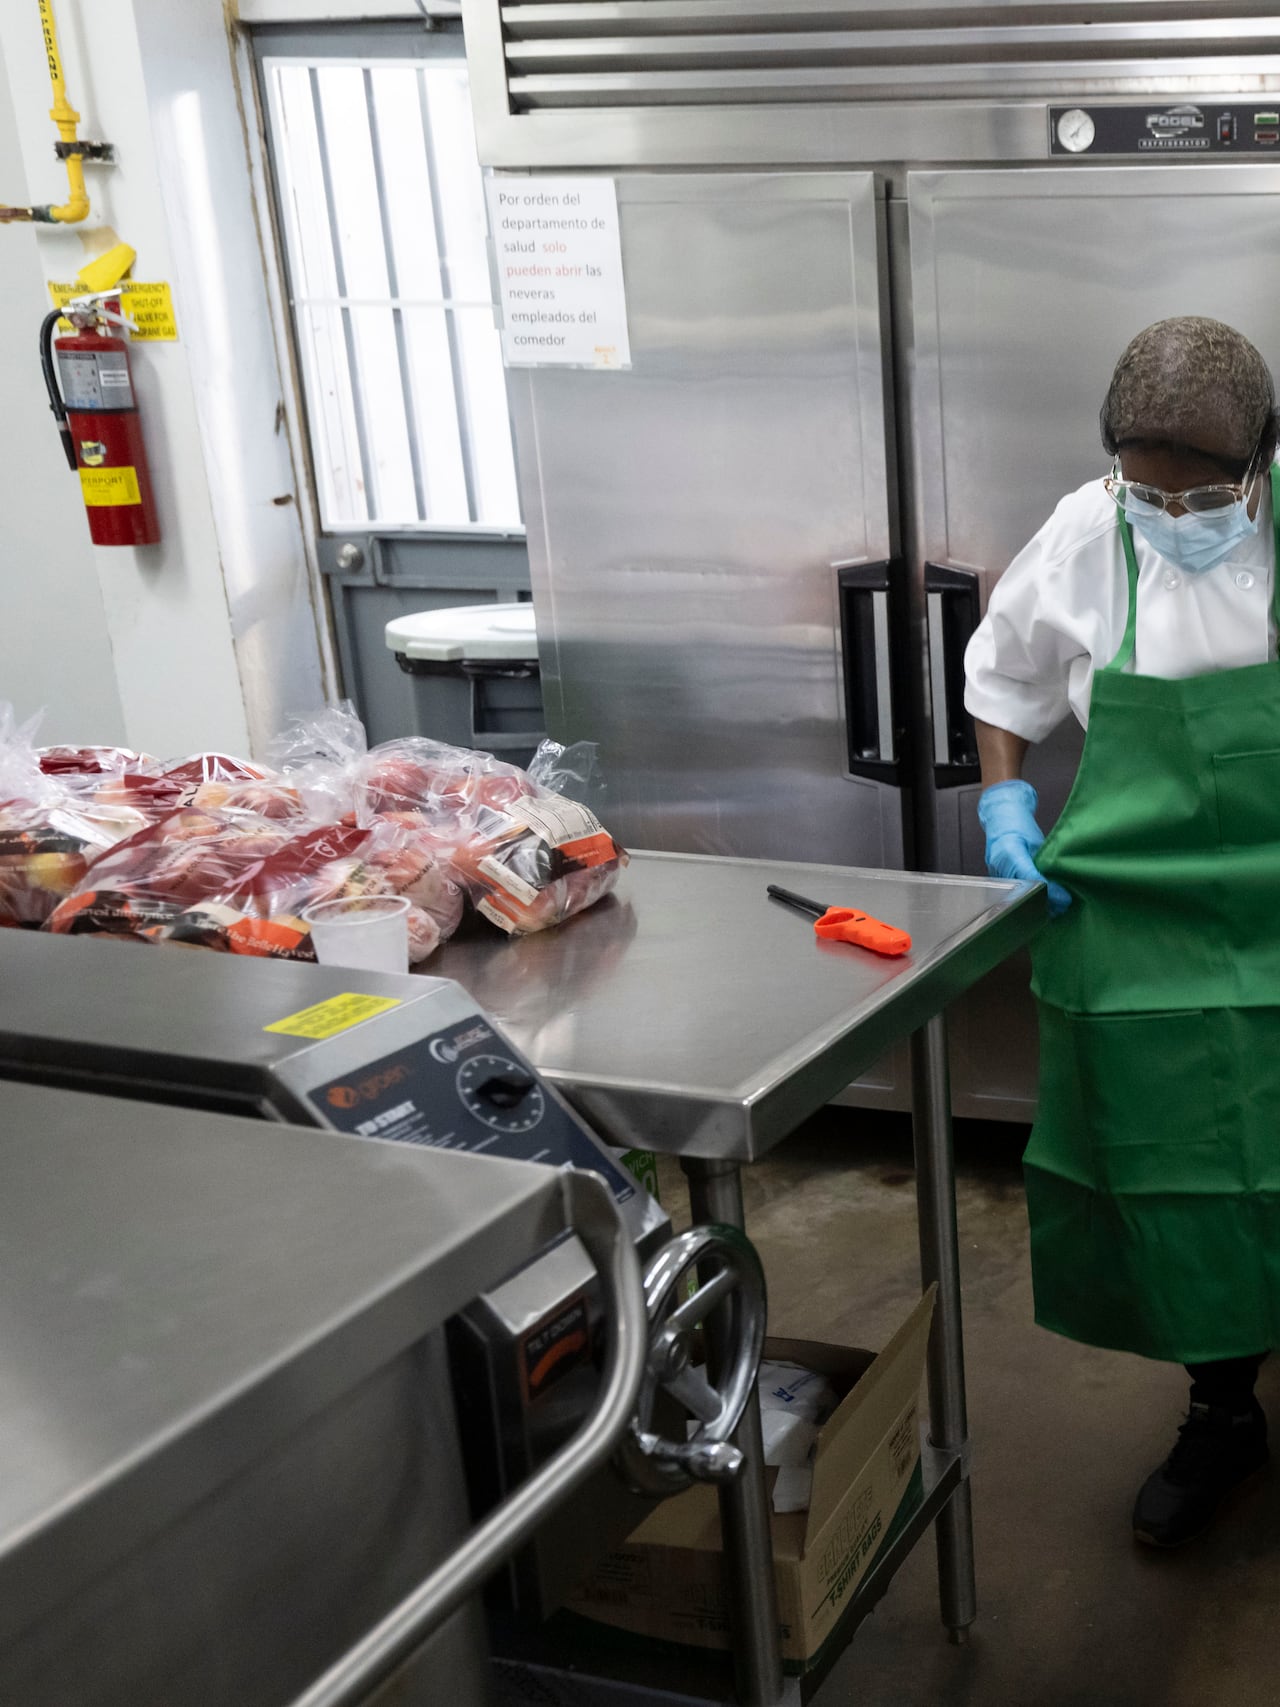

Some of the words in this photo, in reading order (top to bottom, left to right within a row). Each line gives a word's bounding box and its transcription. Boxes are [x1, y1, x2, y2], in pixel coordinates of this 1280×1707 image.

[1140, 140, 1208, 149] REFRIGERATOR
[499, 193, 519, 206] Por
[524, 193, 558, 206] orden
[562, 193, 581, 206] del
[501, 217, 588, 231] departamento
[591, 217, 605, 230] de
[504, 240, 535, 253] salud
[542, 240, 567, 253] solo
[506, 264, 551, 279] pueden
[555, 264, 582, 276] abrir
[586, 264, 602, 276] las
[509, 289, 555, 300] neveras
[511, 312, 575, 325] empleados
[578, 312, 597, 323] del
[514, 334, 566, 346] comedor
[828, 1552, 862, 1608] T-SHIRT
[861, 1516, 882, 1557] BAGS
